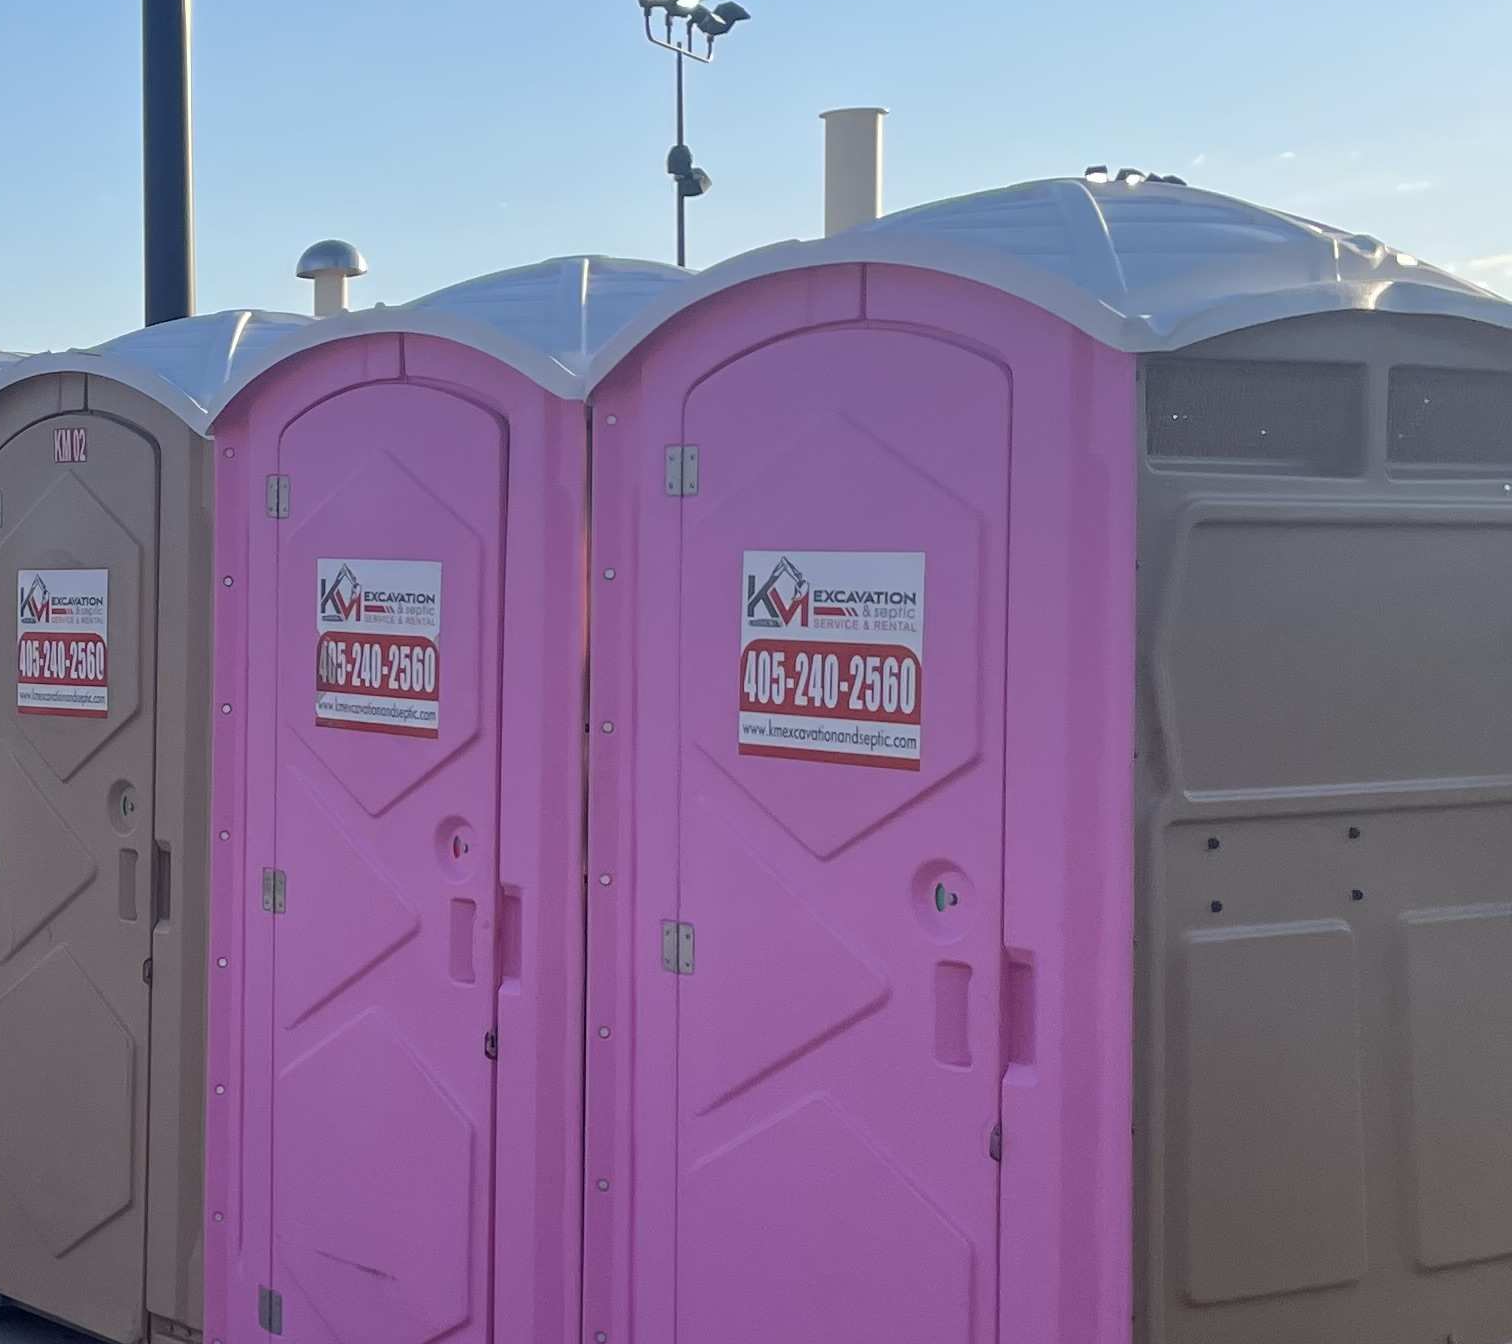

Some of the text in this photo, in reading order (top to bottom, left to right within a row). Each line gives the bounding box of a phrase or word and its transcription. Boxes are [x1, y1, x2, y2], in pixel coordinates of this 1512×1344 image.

[54, 429, 86, 462] KM 02
[20, 586, 50, 623] KM
[51, 597, 104, 606] EXCAVATION
[320, 578, 436, 622] KM EXCAVATION
[747, 572, 917, 628] KM EXCAVATION
[862, 606, 915, 620] & septic
[813, 618, 917, 633] SERVICE & RENTAL
[20, 640, 105, 681] 405-240-2560
[743, 650, 917, 715] 405-240-2560
[742, 719, 917, 750] www.kmexcavationandseptic.com
